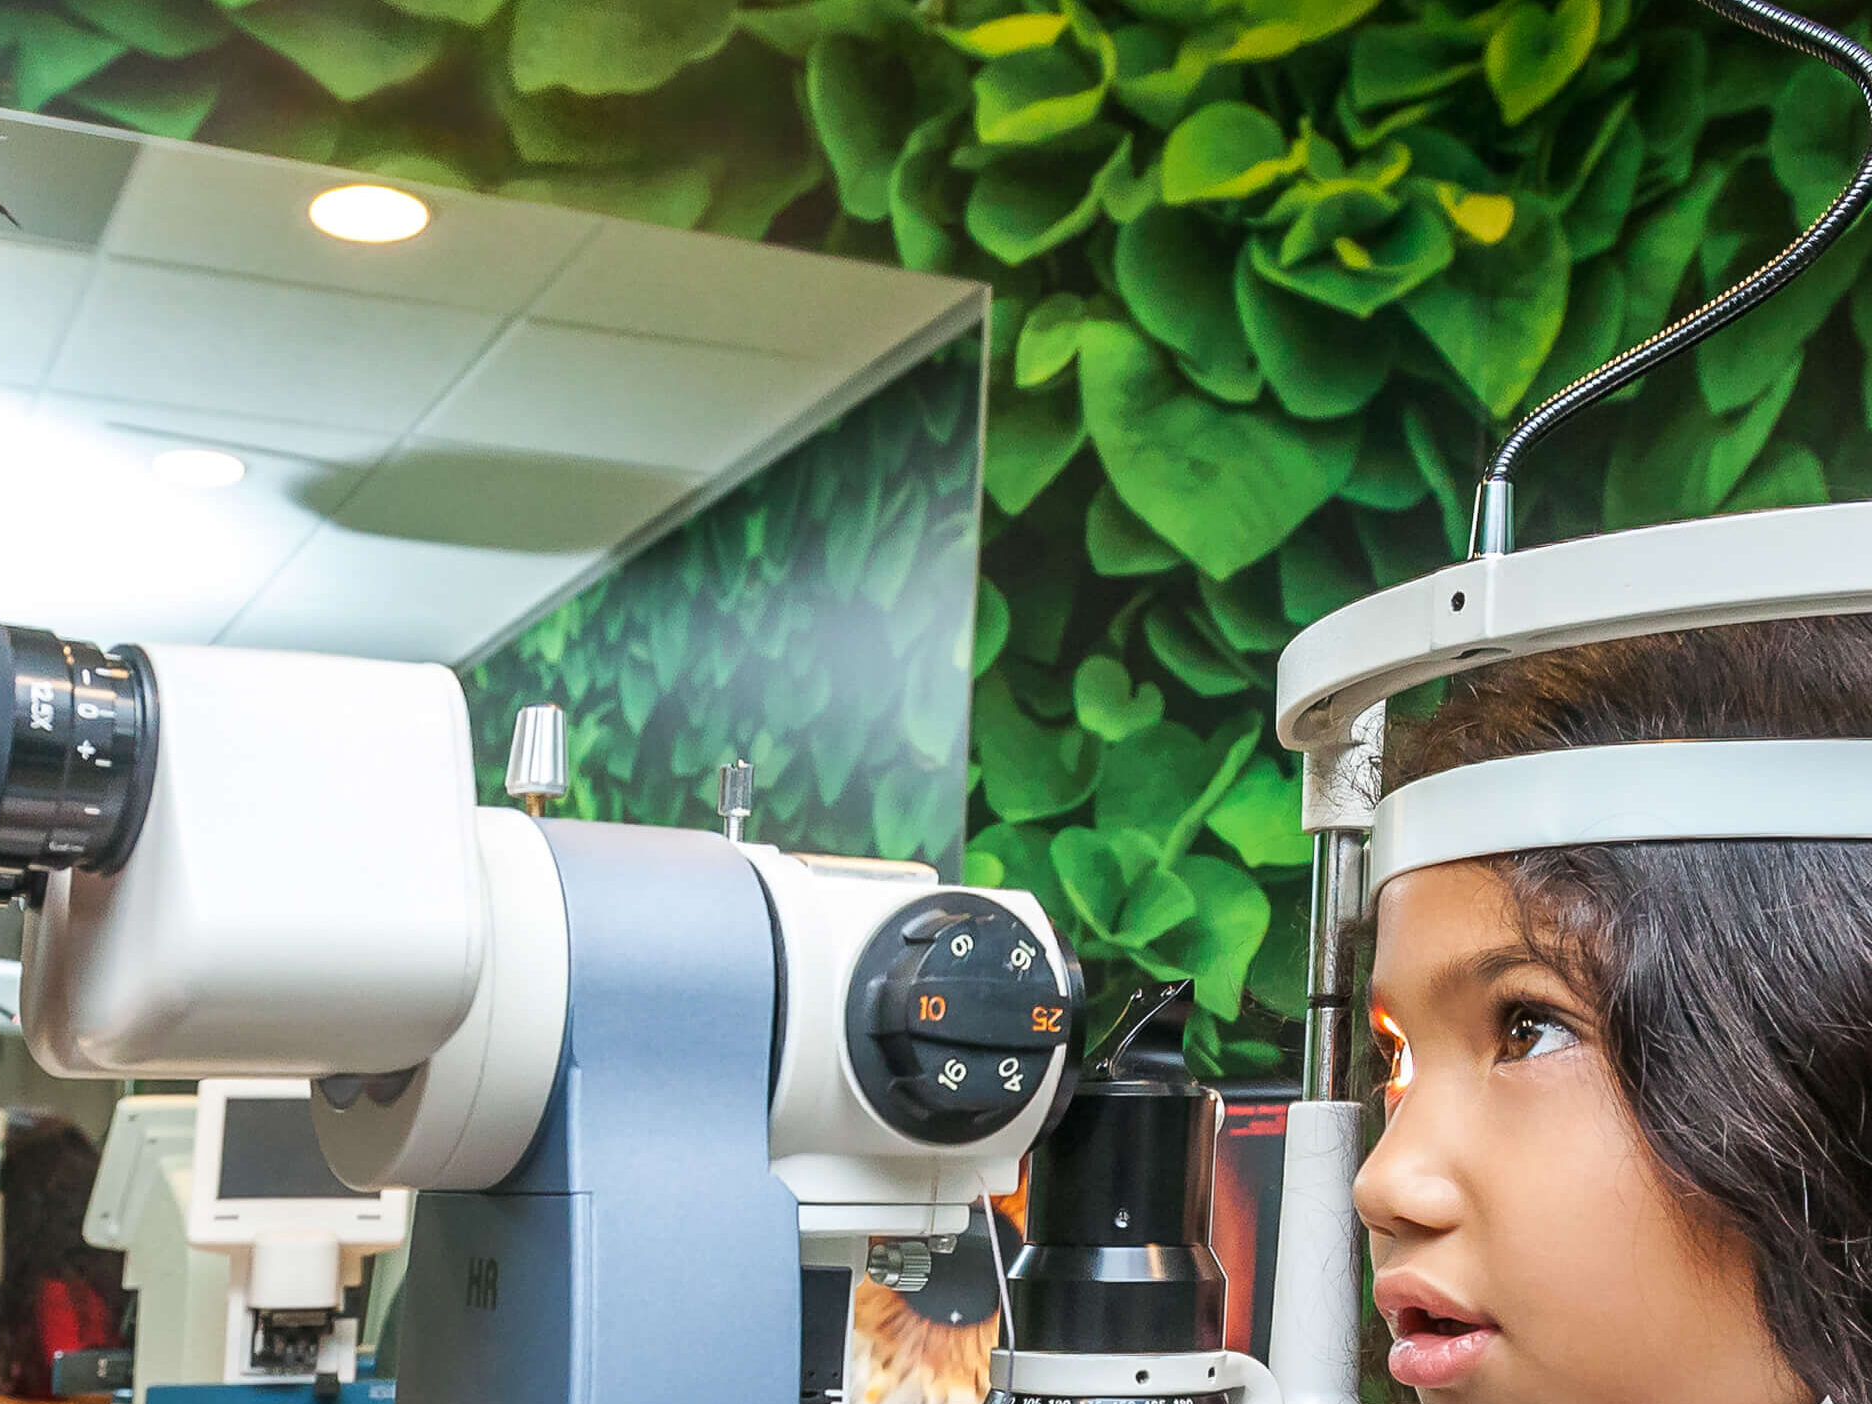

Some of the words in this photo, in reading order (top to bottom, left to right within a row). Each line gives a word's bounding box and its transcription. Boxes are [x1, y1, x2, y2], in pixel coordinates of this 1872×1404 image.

[1010, 939, 1037, 971] 16
[919, 995, 947, 1022] 10
[1031, 1005, 1064, 1033] 25
[937, 1058, 968, 1091] 16
[997, 1057, 1025, 1092] 40
